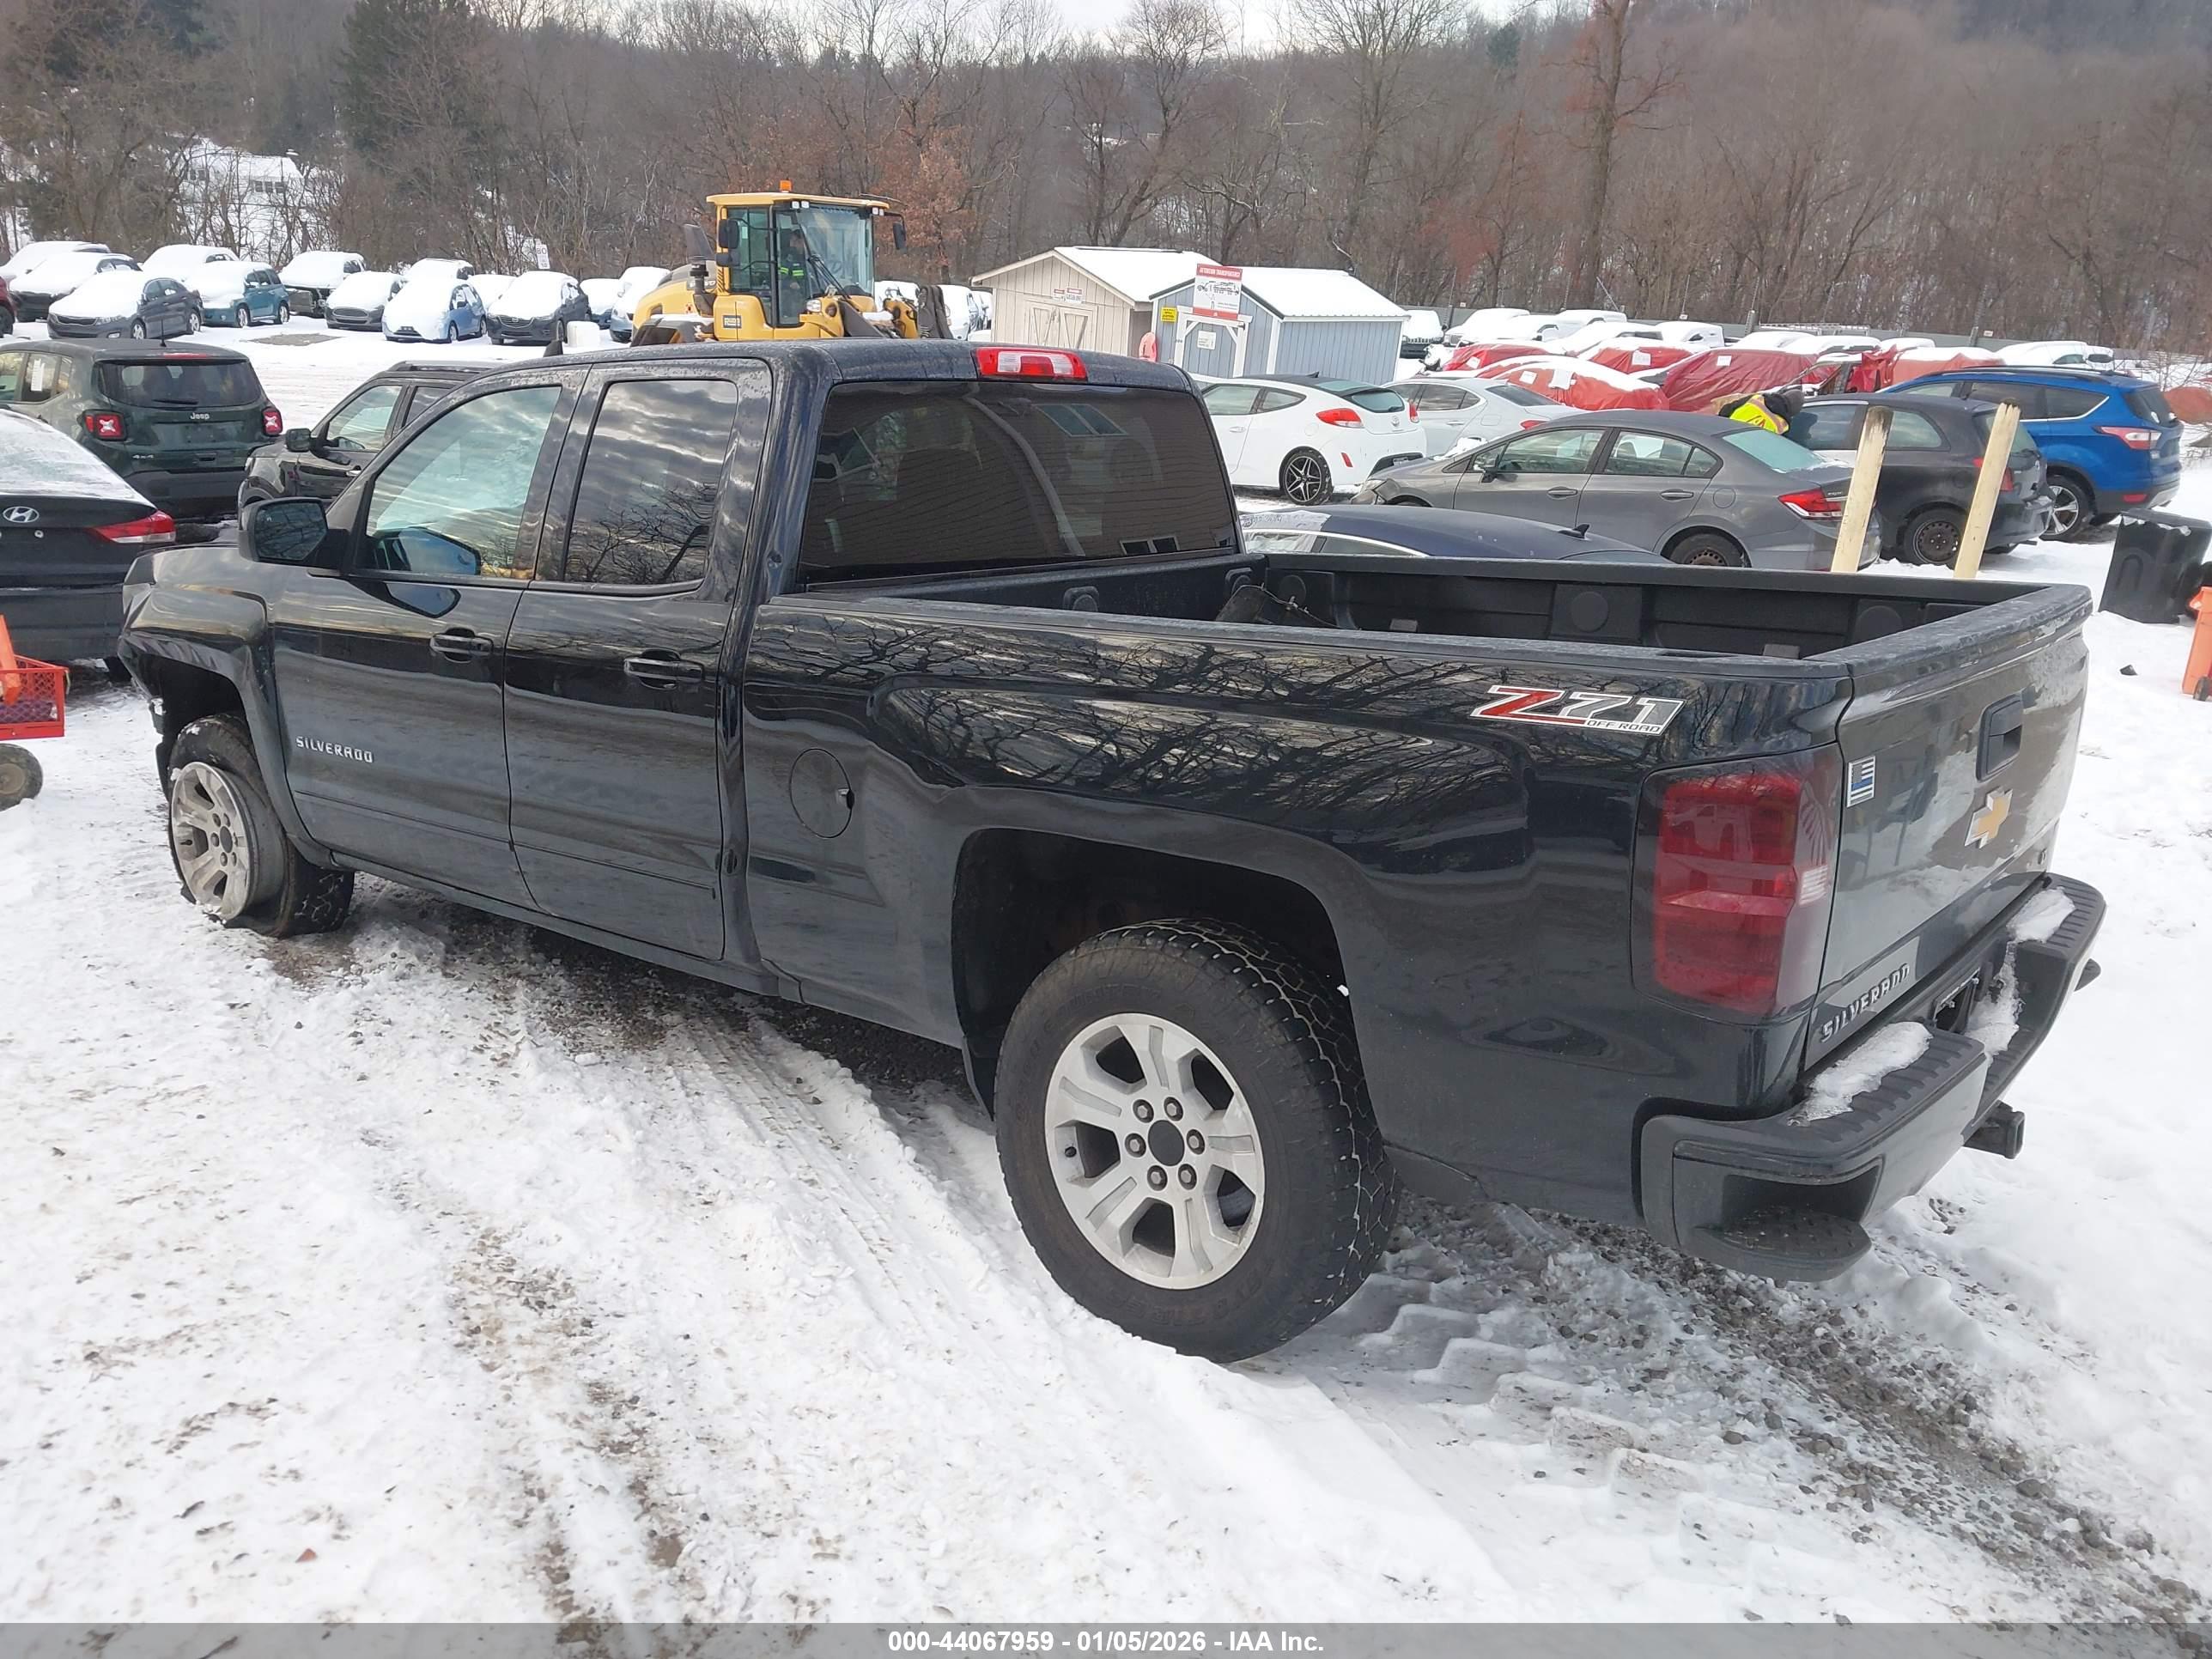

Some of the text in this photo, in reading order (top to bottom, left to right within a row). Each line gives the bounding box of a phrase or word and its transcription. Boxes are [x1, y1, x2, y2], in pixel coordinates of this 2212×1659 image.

[190, 412, 210, 421] Jeep
[1469, 684, 1686, 727] Z71
[1587, 720, 1661, 732] OFF ROAD
[295, 736, 374, 763] SILVERADO
[1820, 963, 1910, 1043] SILVERADO
